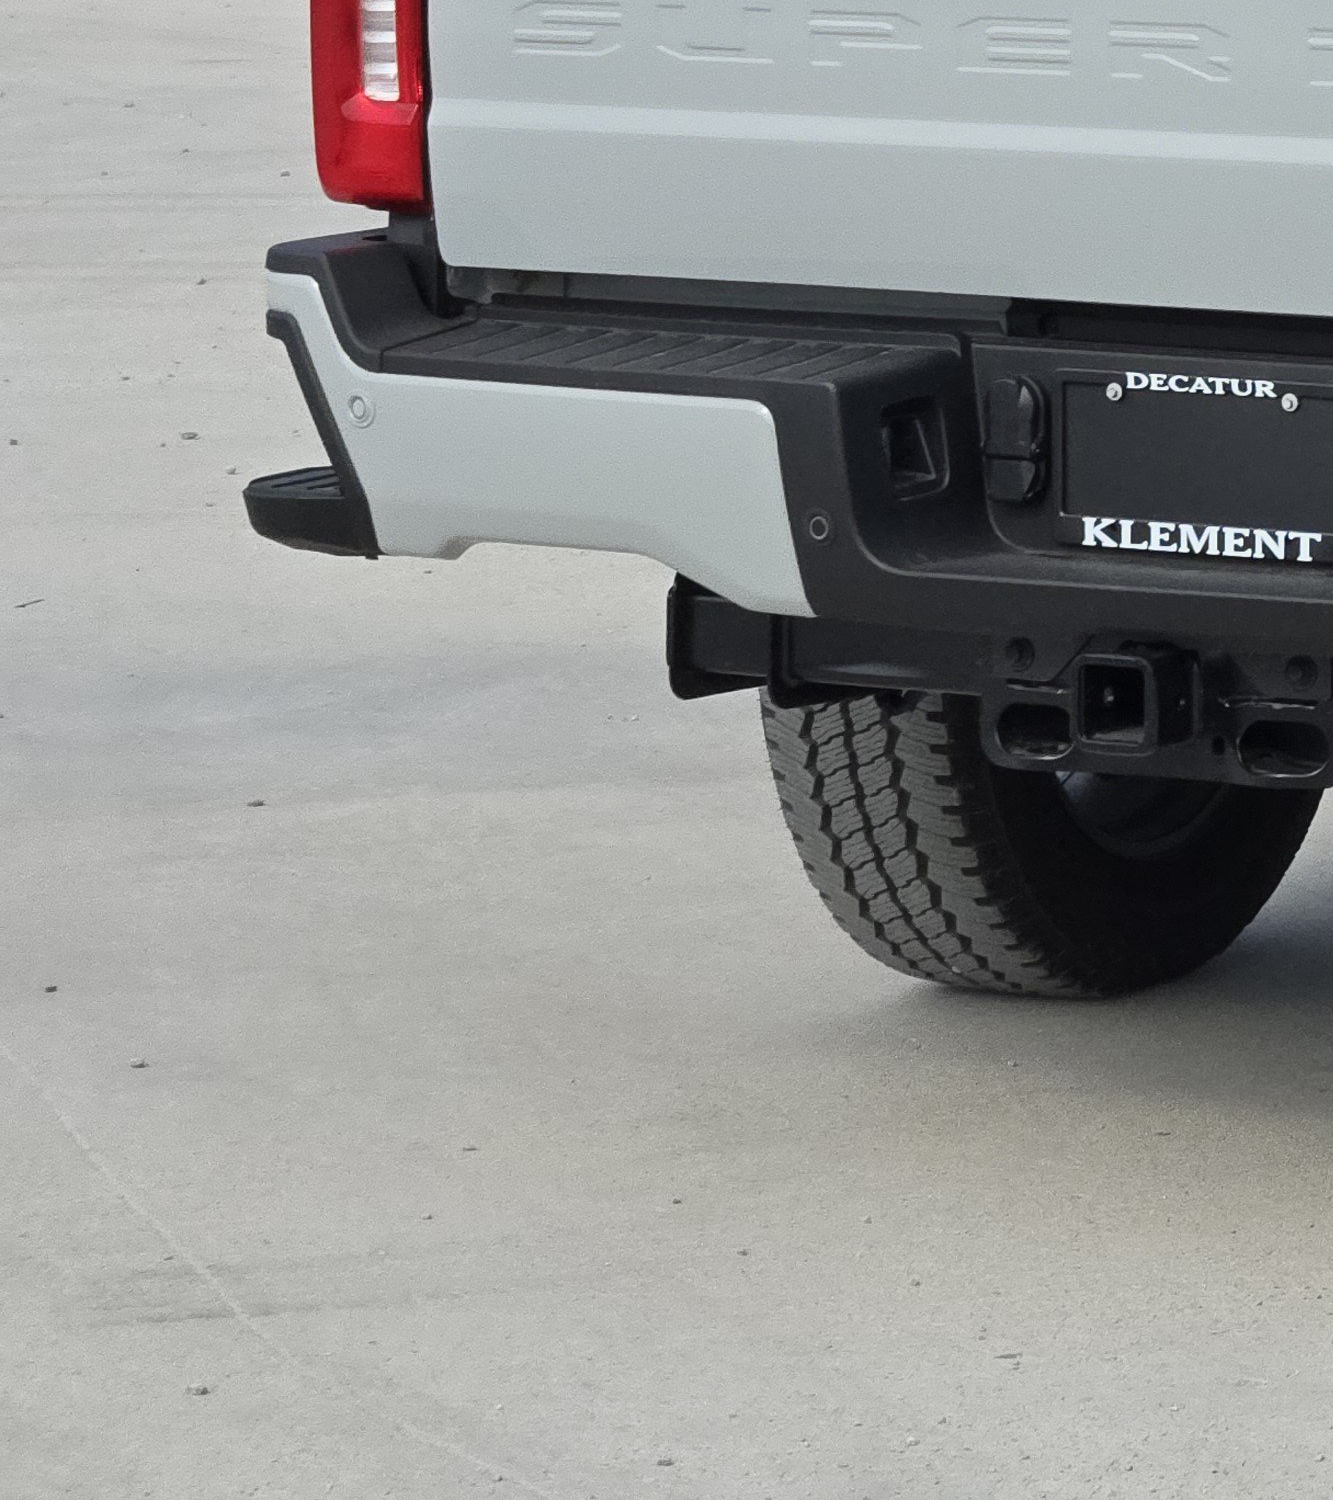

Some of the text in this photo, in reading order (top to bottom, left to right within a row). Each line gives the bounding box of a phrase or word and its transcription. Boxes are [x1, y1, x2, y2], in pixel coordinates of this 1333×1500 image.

[513, 0, 1231, 82] SUPER
[1125, 371, 1278, 398] DECATUR
[1081, 516, 1323, 562] KLEMENT
